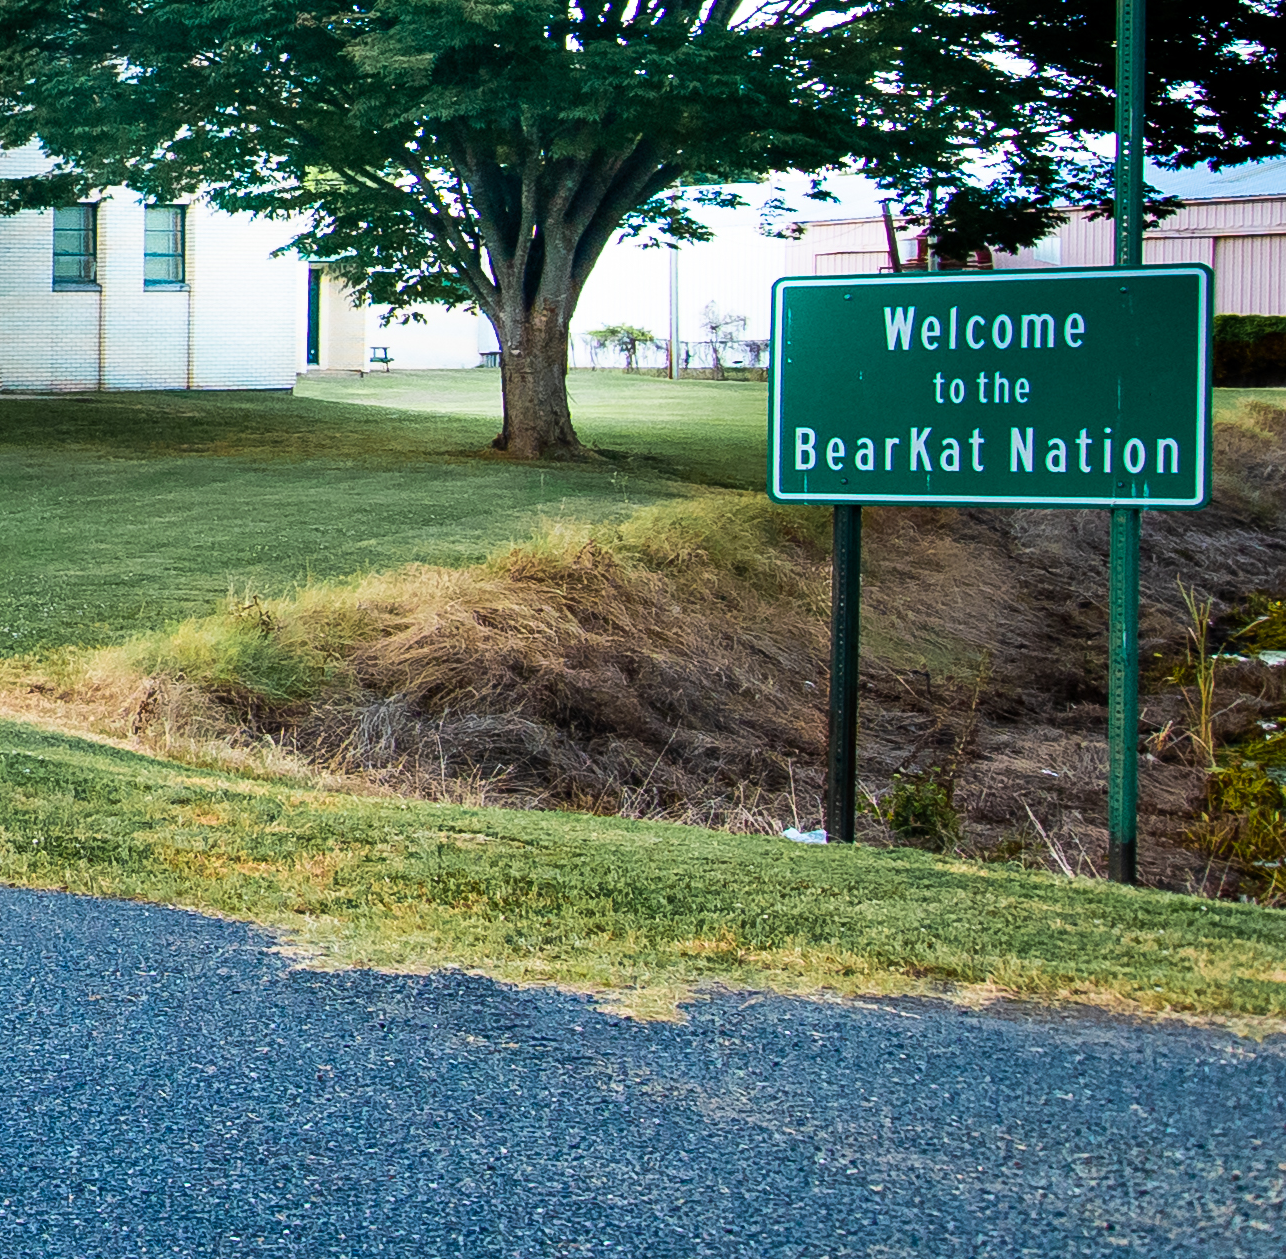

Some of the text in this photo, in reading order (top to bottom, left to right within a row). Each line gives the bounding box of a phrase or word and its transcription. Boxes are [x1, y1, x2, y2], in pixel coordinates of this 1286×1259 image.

[883, 306, 1086, 351] Welcome
[933, 371, 1031, 404] to the
[794, 427, 1180, 474] BearKat Nation
